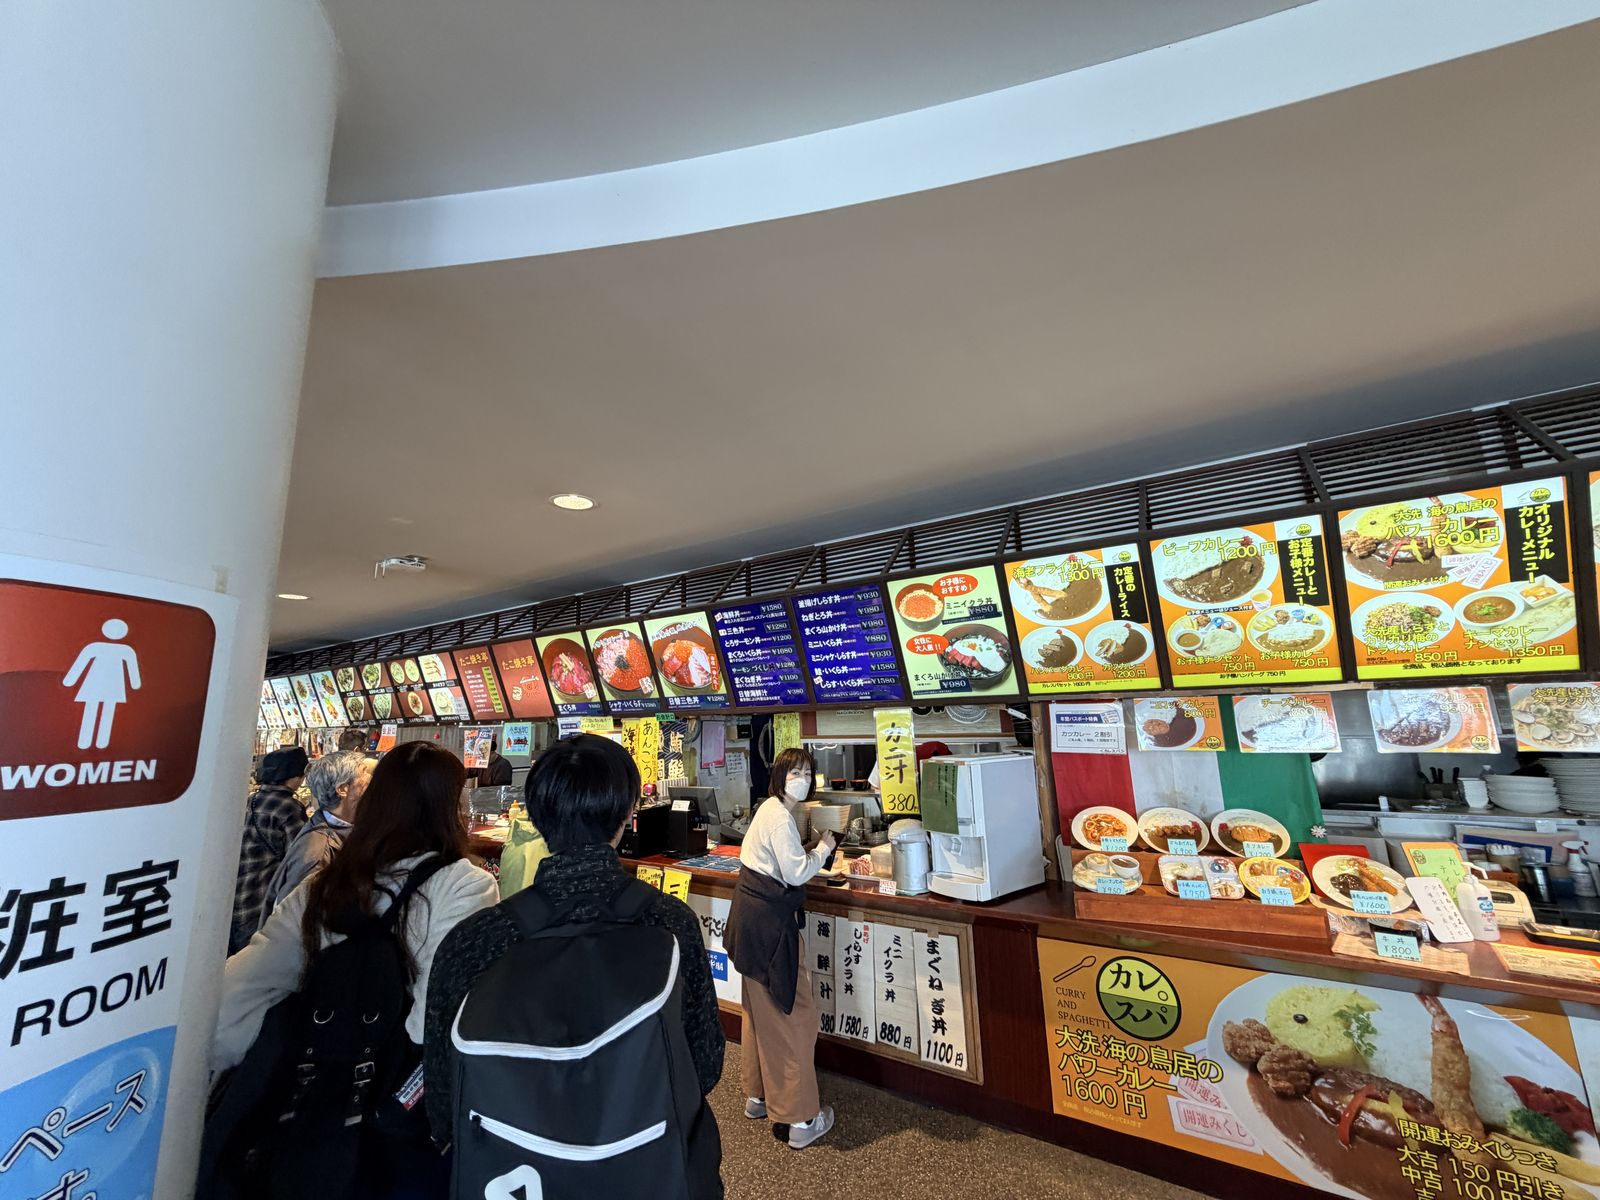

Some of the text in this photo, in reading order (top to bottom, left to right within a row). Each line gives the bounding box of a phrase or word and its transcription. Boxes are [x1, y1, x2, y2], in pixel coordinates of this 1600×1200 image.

[1395, 498, 1497, 522] 大洗 海の鳥居の
[1385, 516, 1498, 540] パワーカレー
[1534, 503, 1555, 560] オリジナル
[1162, 536, 1245, 556] ビーフカレー
[1423, 526, 1499, 550] 1600円
[1517, 506, 1540, 583] カレーメニュー
[1218, 540, 1278, 561] 1200円
[1012, 558, 1104, 579] 海老フライカレー
[1059, 565, 1105, 584] 1300円
[1287, 540, 1307, 606] お子様メニュー
[1300, 537, 1318, 596] 定番カレーと
[939, 576, 966, 587] お子様に
[1123, 566, 1136, 592] 定番の
[1113, 566, 1131, 618] カレーライス
[798, 594, 841, 609] 釜揚げしらす丼
[945, 597, 993, 610] ミニイクラ丼
[970, 604, 994, 616] ¥880
[801, 610, 833, 622] ねぎとろ丼
[726, 626, 745, 636] 三色丼
[804, 623, 847, 636] まぐろ山かけ丼
[1364, 621, 1450, 636] 大洗産しらすと
[1462, 625, 1550, 640] キーマカレー
[724, 636, 761, 648] とろサーモン丼
[808, 636, 843, 649] ミニいくら丼
[914, 637, 932, 646] 女性に
[1364, 632, 1439, 646] カリカリ梅の
[1464, 637, 1533, 651] ナンセット
[727, 648, 762, 659] まぐろいくら丼
[811, 650, 857, 663] ミニシャケ・しらす丼
[1260, 650, 1325, 661] お子様カレー
[1365, 643, 1440, 657] ドライカレー
[1414, 650, 1458, 662] 850円
[1508, 645, 1565, 658] 1350円
[459, 652, 489, 667] たこ焼き亭
[502, 656, 534, 671] たこ焼き亭
[1103, 662, 1146, 673] カツカレー
[1175, 653, 1251, 666] お子様ナンセット
[1223, 661, 1256, 672] 750円
[1292, 657, 1329, 668] 750円
[734, 675, 762, 684] まぐねぎ丼
[1113, 668, 1147, 679] 1200円
[820, 678, 864, 691] しらす・いくら丼
[668, 694, 699, 706] 日替三色丼
[1260, 696, 1326, 708] チーズカレー
[641, 720, 654, 779] あんこう
[2, 759, 158, 791] WOMEN
[854, 926, 865, 966] しらす
[893, 933, 904, 960] ミニ
[1384, 945, 1412, 956] ¥800
[818, 919, 834, 1000] 海鮮汁
[843, 943, 857, 998] イクラ丼
[884, 944, 898, 1003] イクラ丼
[926, 937, 949, 1037] まぐねぎ丼
[1055, 987, 1087, 1001] CURRY
[11, 956, 168, 1048] ROOM
[1056, 999, 1078, 1011] AND
[1057, 1010, 1112, 1031] SPAGHETTI
[1113, 999, 1168, 1026] スパ
[879, 1020, 913, 1050] 880円
[926, 1038, 965, 1069] 1100円
[1055, 1025, 1224, 1084] 大洗 海の鳥居の
[1058, 1052, 1178, 1093] パワーカレー
[1062, 1074, 1147, 1120] 1600円
[1184, 1076, 1229, 1110] 開運み
[1182, 1106, 1248, 1140] 開運みくじ
[1397, 1118, 1559, 1174] 開運おみくじつき
[1396, 1145, 1439, 1171] 大吉
[1401, 1164, 1444, 1193] 中吉
